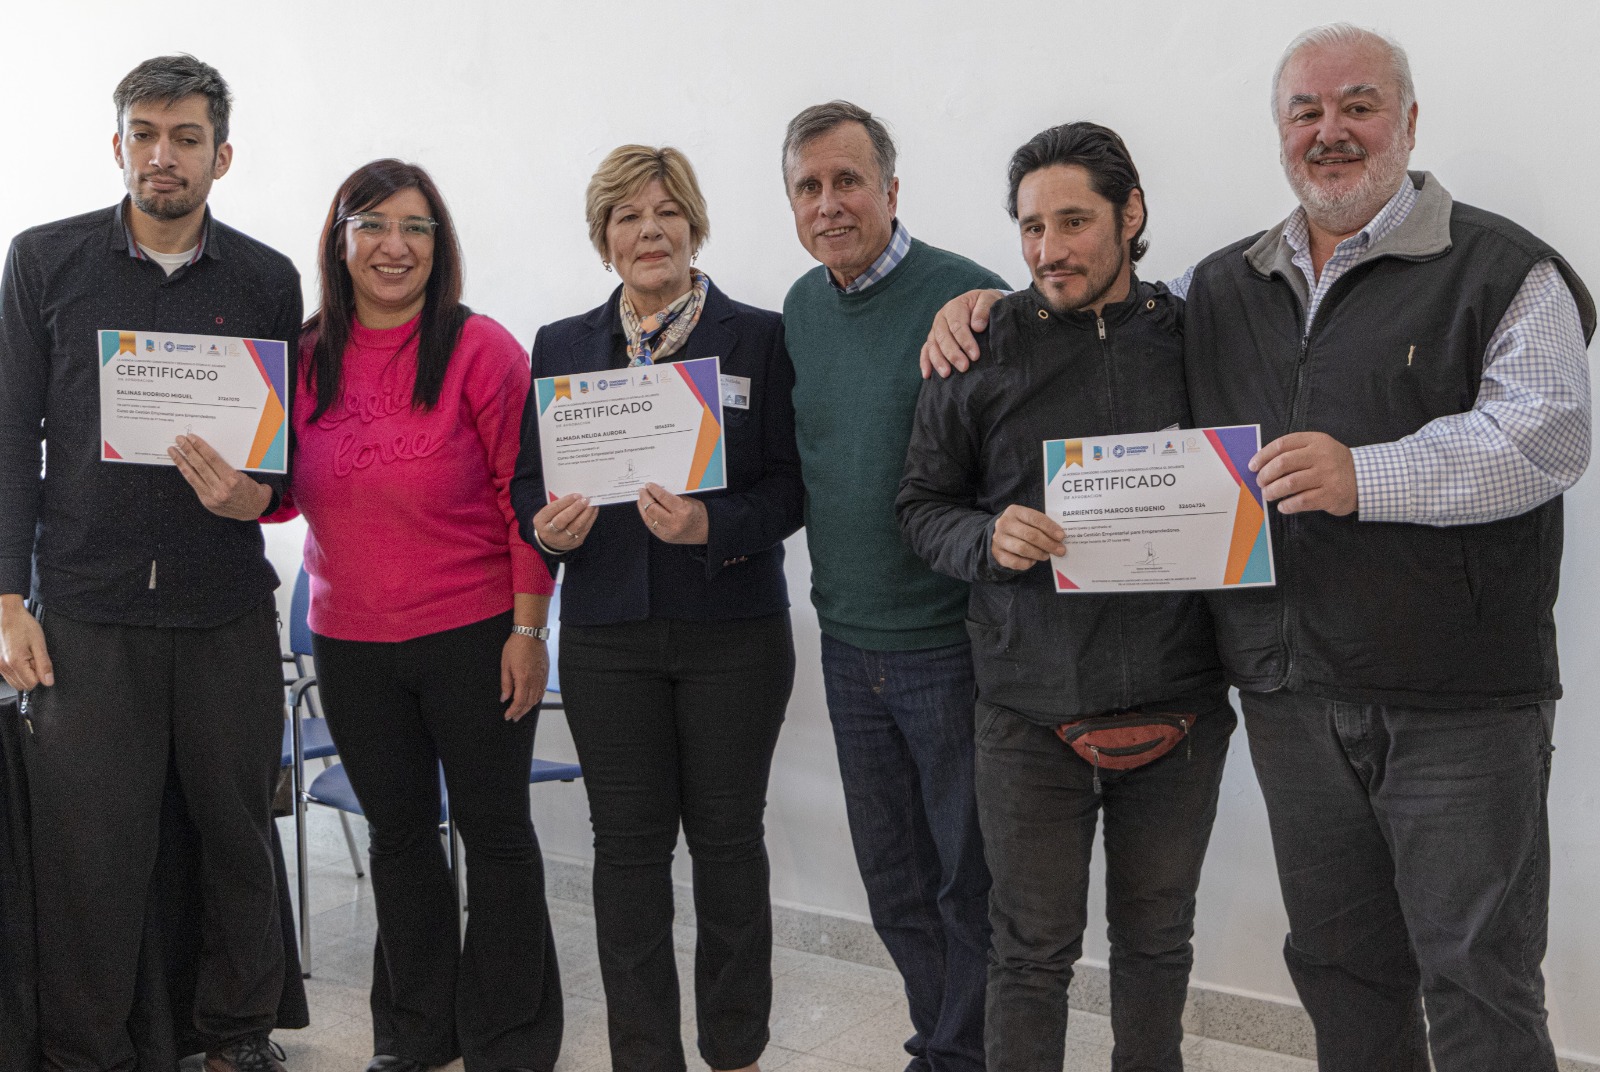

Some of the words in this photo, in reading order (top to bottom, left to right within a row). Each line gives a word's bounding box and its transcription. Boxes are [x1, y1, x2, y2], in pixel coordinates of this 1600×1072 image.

[116, 364, 218, 381] CERTIFICADO
[553, 400, 653, 422] CERTIFICADO
[556, 434, 581, 443] ALMADA
[603, 428, 626, 437] AURORA
[1062, 473, 1176, 493] CERTIFICADO
[1062, 508, 1103, 517] BARRIENTOS
[1104, 506, 1134, 514] MARCOS
[1135, 504, 1166, 512] EUGENIO
